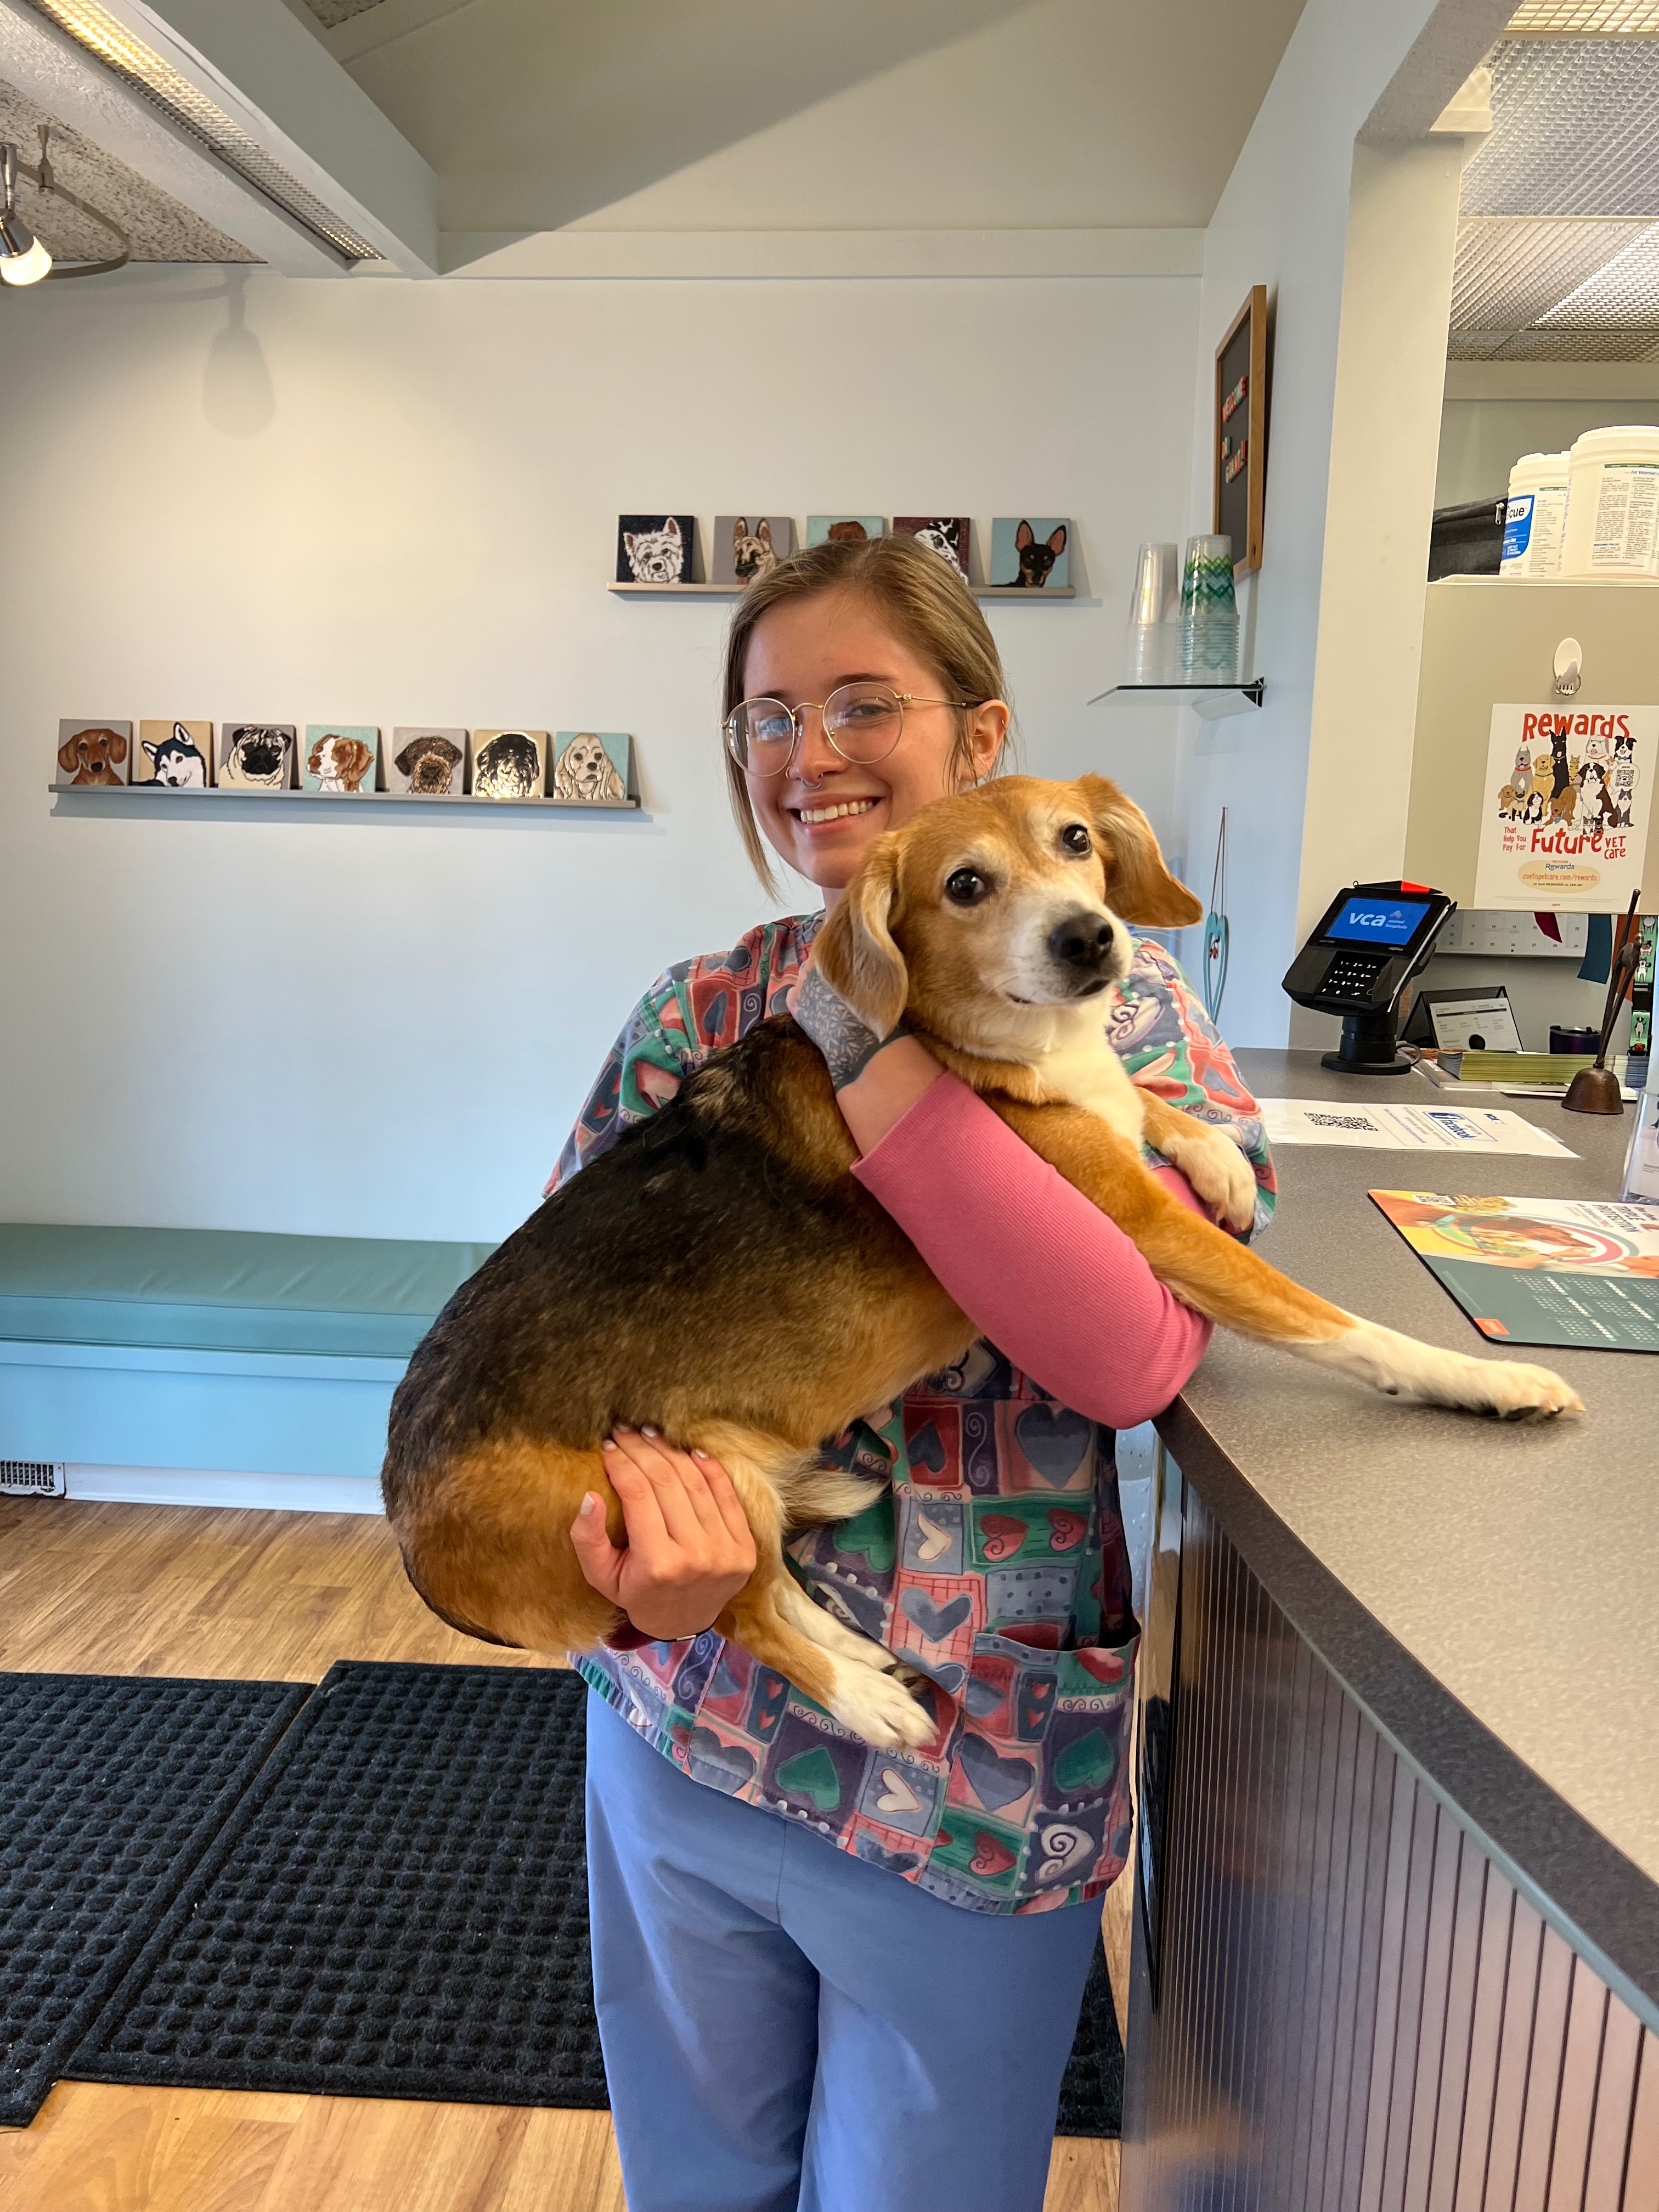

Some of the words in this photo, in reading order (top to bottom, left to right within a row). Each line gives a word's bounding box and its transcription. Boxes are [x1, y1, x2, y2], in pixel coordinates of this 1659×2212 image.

[1522, 713, 1630, 743] Rewards
[1503, 835, 1515, 843] Help
[1531, 827, 1603, 854] Future
[1605, 836, 1627, 848] VET
[1503, 844, 1513, 853] Pay
[1604, 848, 1627, 860] care
[1545, 863, 1575, 871] Rewards
[1522, 873, 1597, 881] zoetispetcare.com/rewards
[1350, 912, 1386, 927] vca
